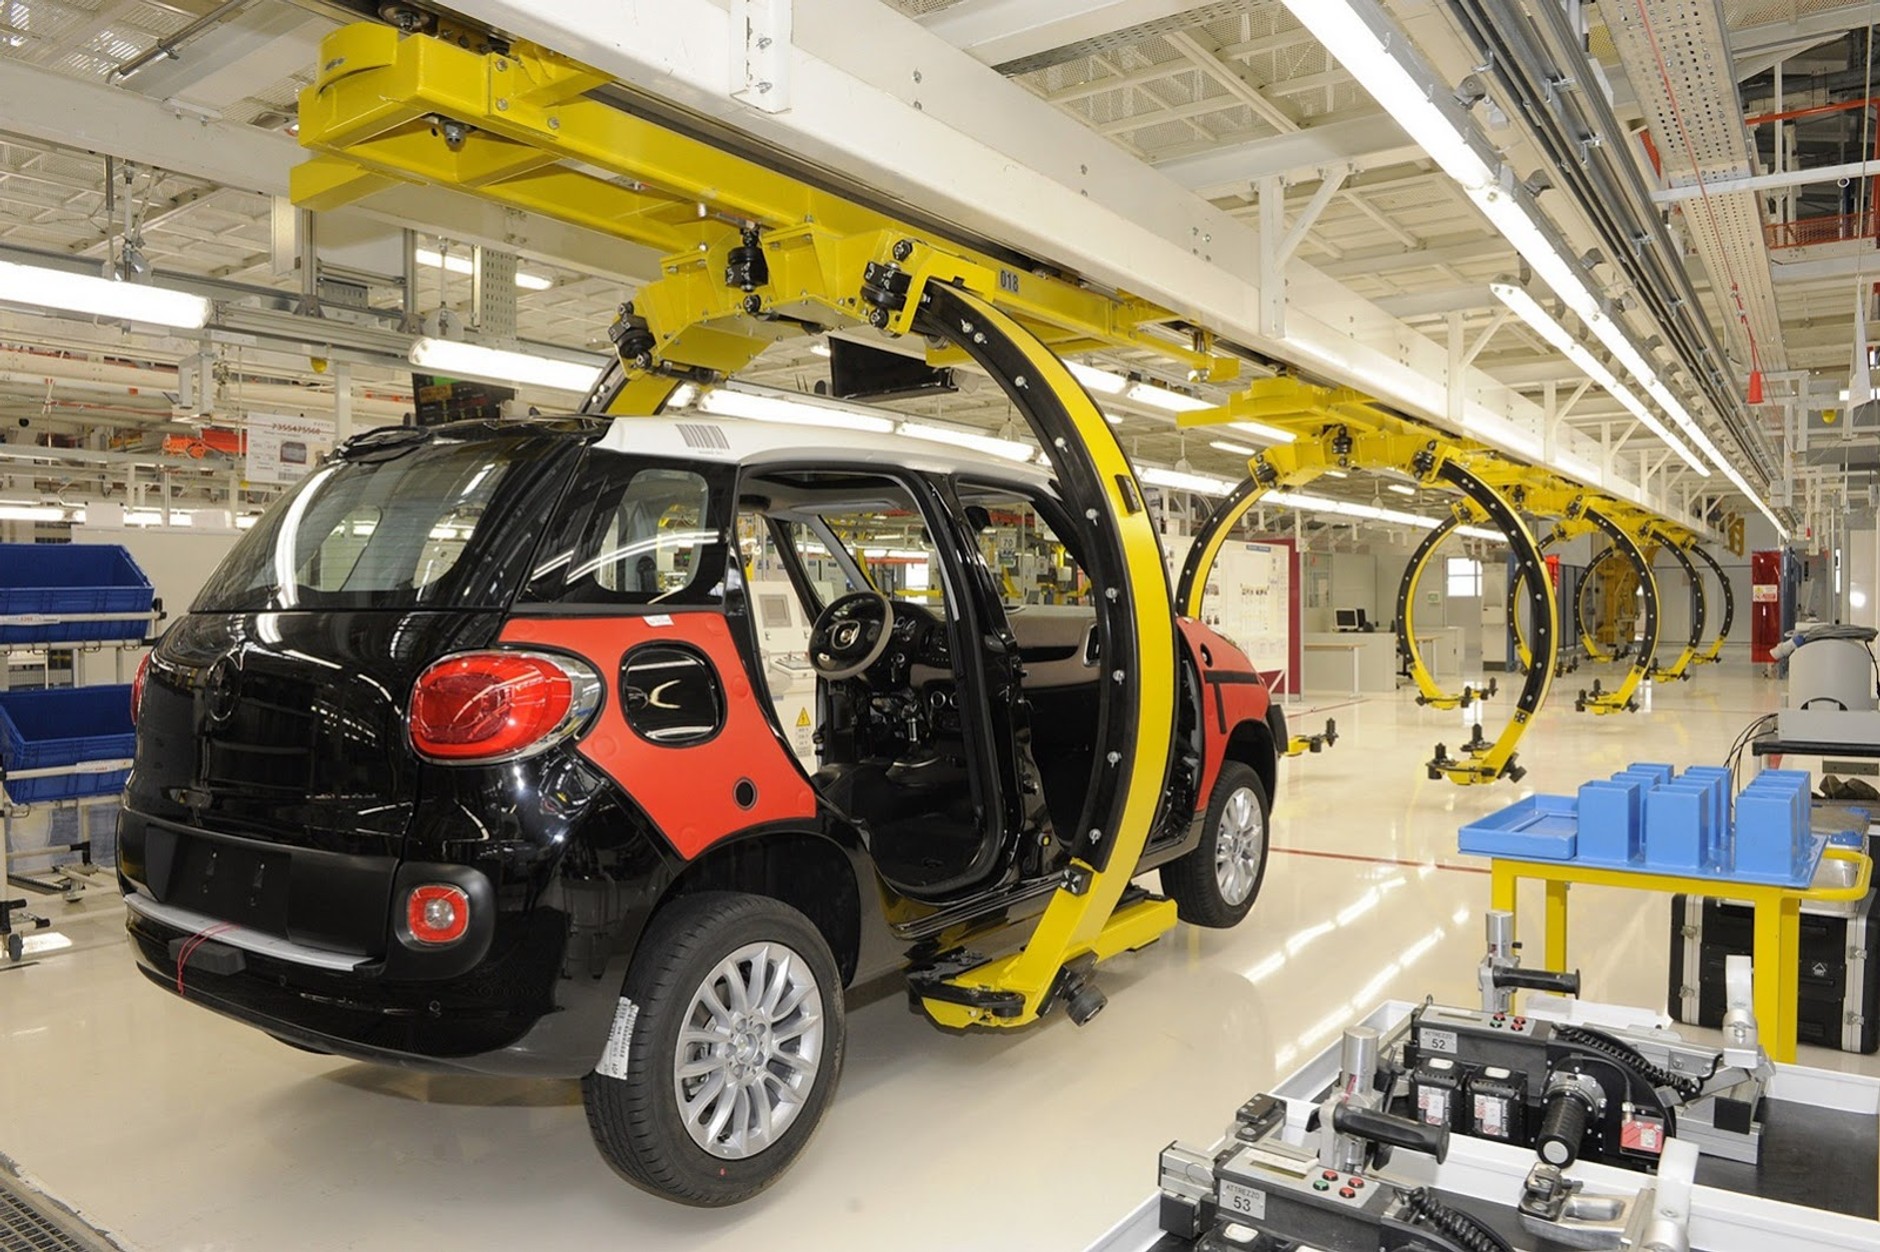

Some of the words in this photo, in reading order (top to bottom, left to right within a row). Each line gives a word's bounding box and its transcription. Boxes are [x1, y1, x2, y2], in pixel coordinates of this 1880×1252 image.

[1000, 270, 1019, 292] 018
[1431, 1038, 1446, 1050] 52
[1233, 1195, 1251, 1212] 53
